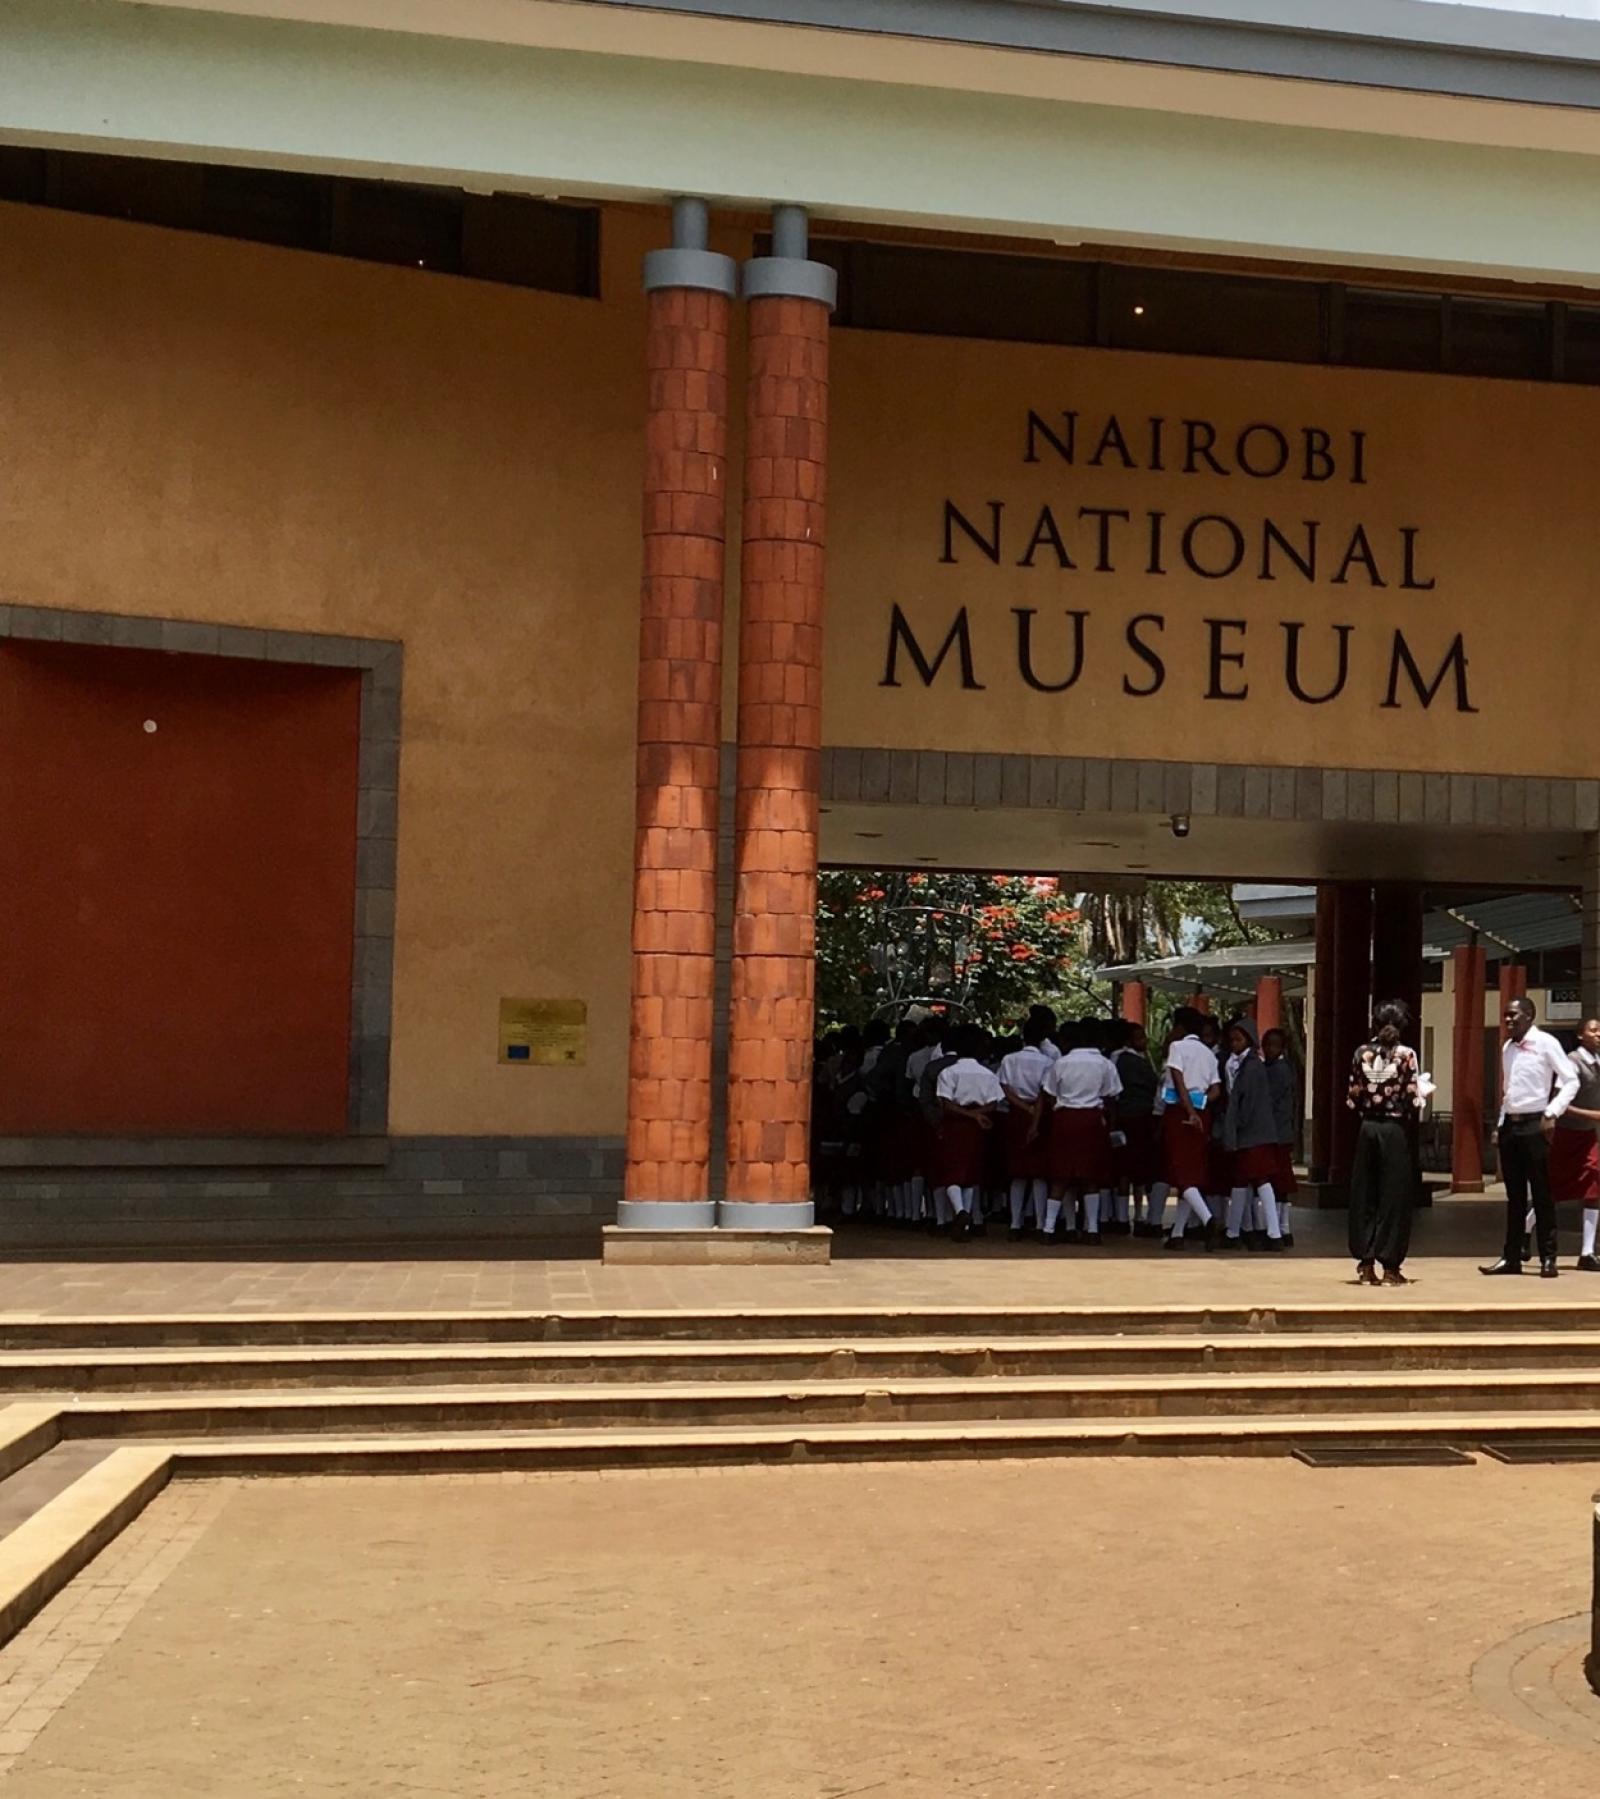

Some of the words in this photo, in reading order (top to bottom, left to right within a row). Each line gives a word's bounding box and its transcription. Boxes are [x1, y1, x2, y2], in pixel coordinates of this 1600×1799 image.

[1023, 409, 1368, 485] NAIROBI
[938, 498, 1436, 591] NATIONAL
[877, 601, 1480, 714] MUSEUM
